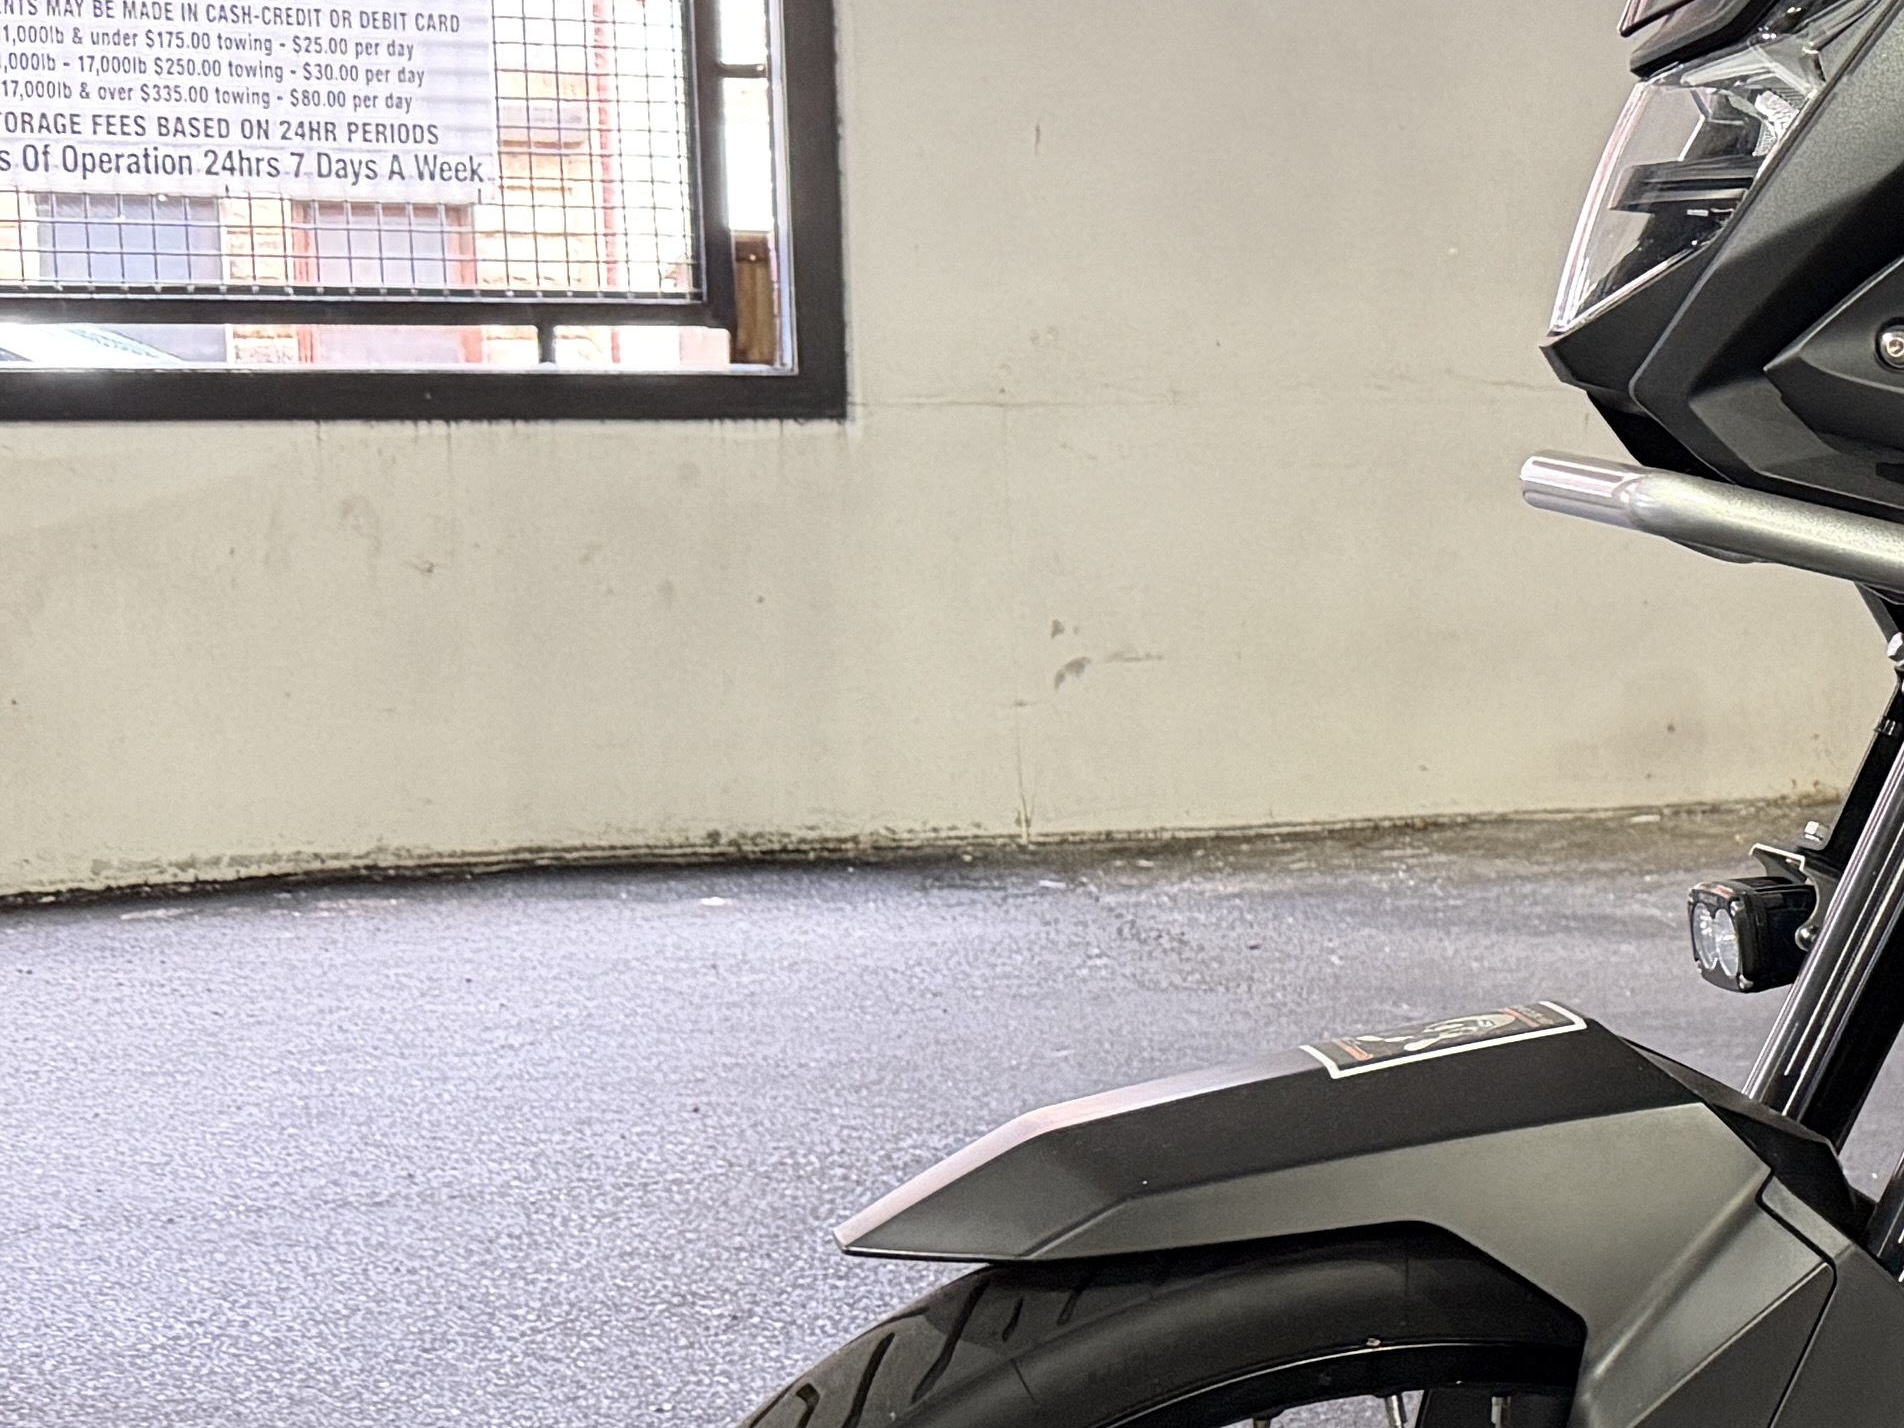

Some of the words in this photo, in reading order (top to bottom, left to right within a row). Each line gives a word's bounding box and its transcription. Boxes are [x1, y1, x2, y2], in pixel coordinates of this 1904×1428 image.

[93, 0, 115, 18] BE
[123, 0, 174, 21] MADE
[181, 2, 198, 22] IN
[206, 3, 322, 28] CASH-CREDIT
[330, 9, 352, 29] OR
[360, 10, 408, 31] DEBIT
[415, 13, 460, 33] CARD
[72, 27, 83, 45] &
[91, 29, 139, 47] under
[146, 31, 211, 50] $175.00
[217, 33, 273, 56] towing
[292, 35, 348, 55] $25.00
[355, 40, 379, 59] per
[387, 39, 414, 61] day
[0, 52, 56, 73] ,000lb
[78, 55, 147, 76] 17,000lb
[154, 57, 222, 78] $250.00
[228, 60, 284, 83] towing
[303, 62, 359, 81] $30.00
[365, 68, 390, 86] per
[398, 66, 425, 88] day
[1, 80, 72, 101] 17,000lb
[79, 82, 90, 99] &
[98, 86, 134, 101] over
[140, 83, 209, 103] $335.00
[215, 86, 271, 110] towing
[290, 88, 346, 108] $80.00
[353, 94, 378, 112] per
[385, 92, 412, 114] day
[0, 111, 82, 135] ORAGE
[91, 113, 147, 137] FEES
[156, 115, 230, 139] BASED
[241, 118, 270, 140] ON
[279, 120, 337, 142] 24HR
[347, 122, 439, 145] PERIODS
[22, 144, 51, 172] Of
[62, 144, 193, 180] Operation
[203, 149, 281, 178] 24hrs
[290, 152, 305, 178] 7
[316, 152, 378, 186] Days
[388, 154, 405, 181] A
[414, 154, 484, 182] Week
